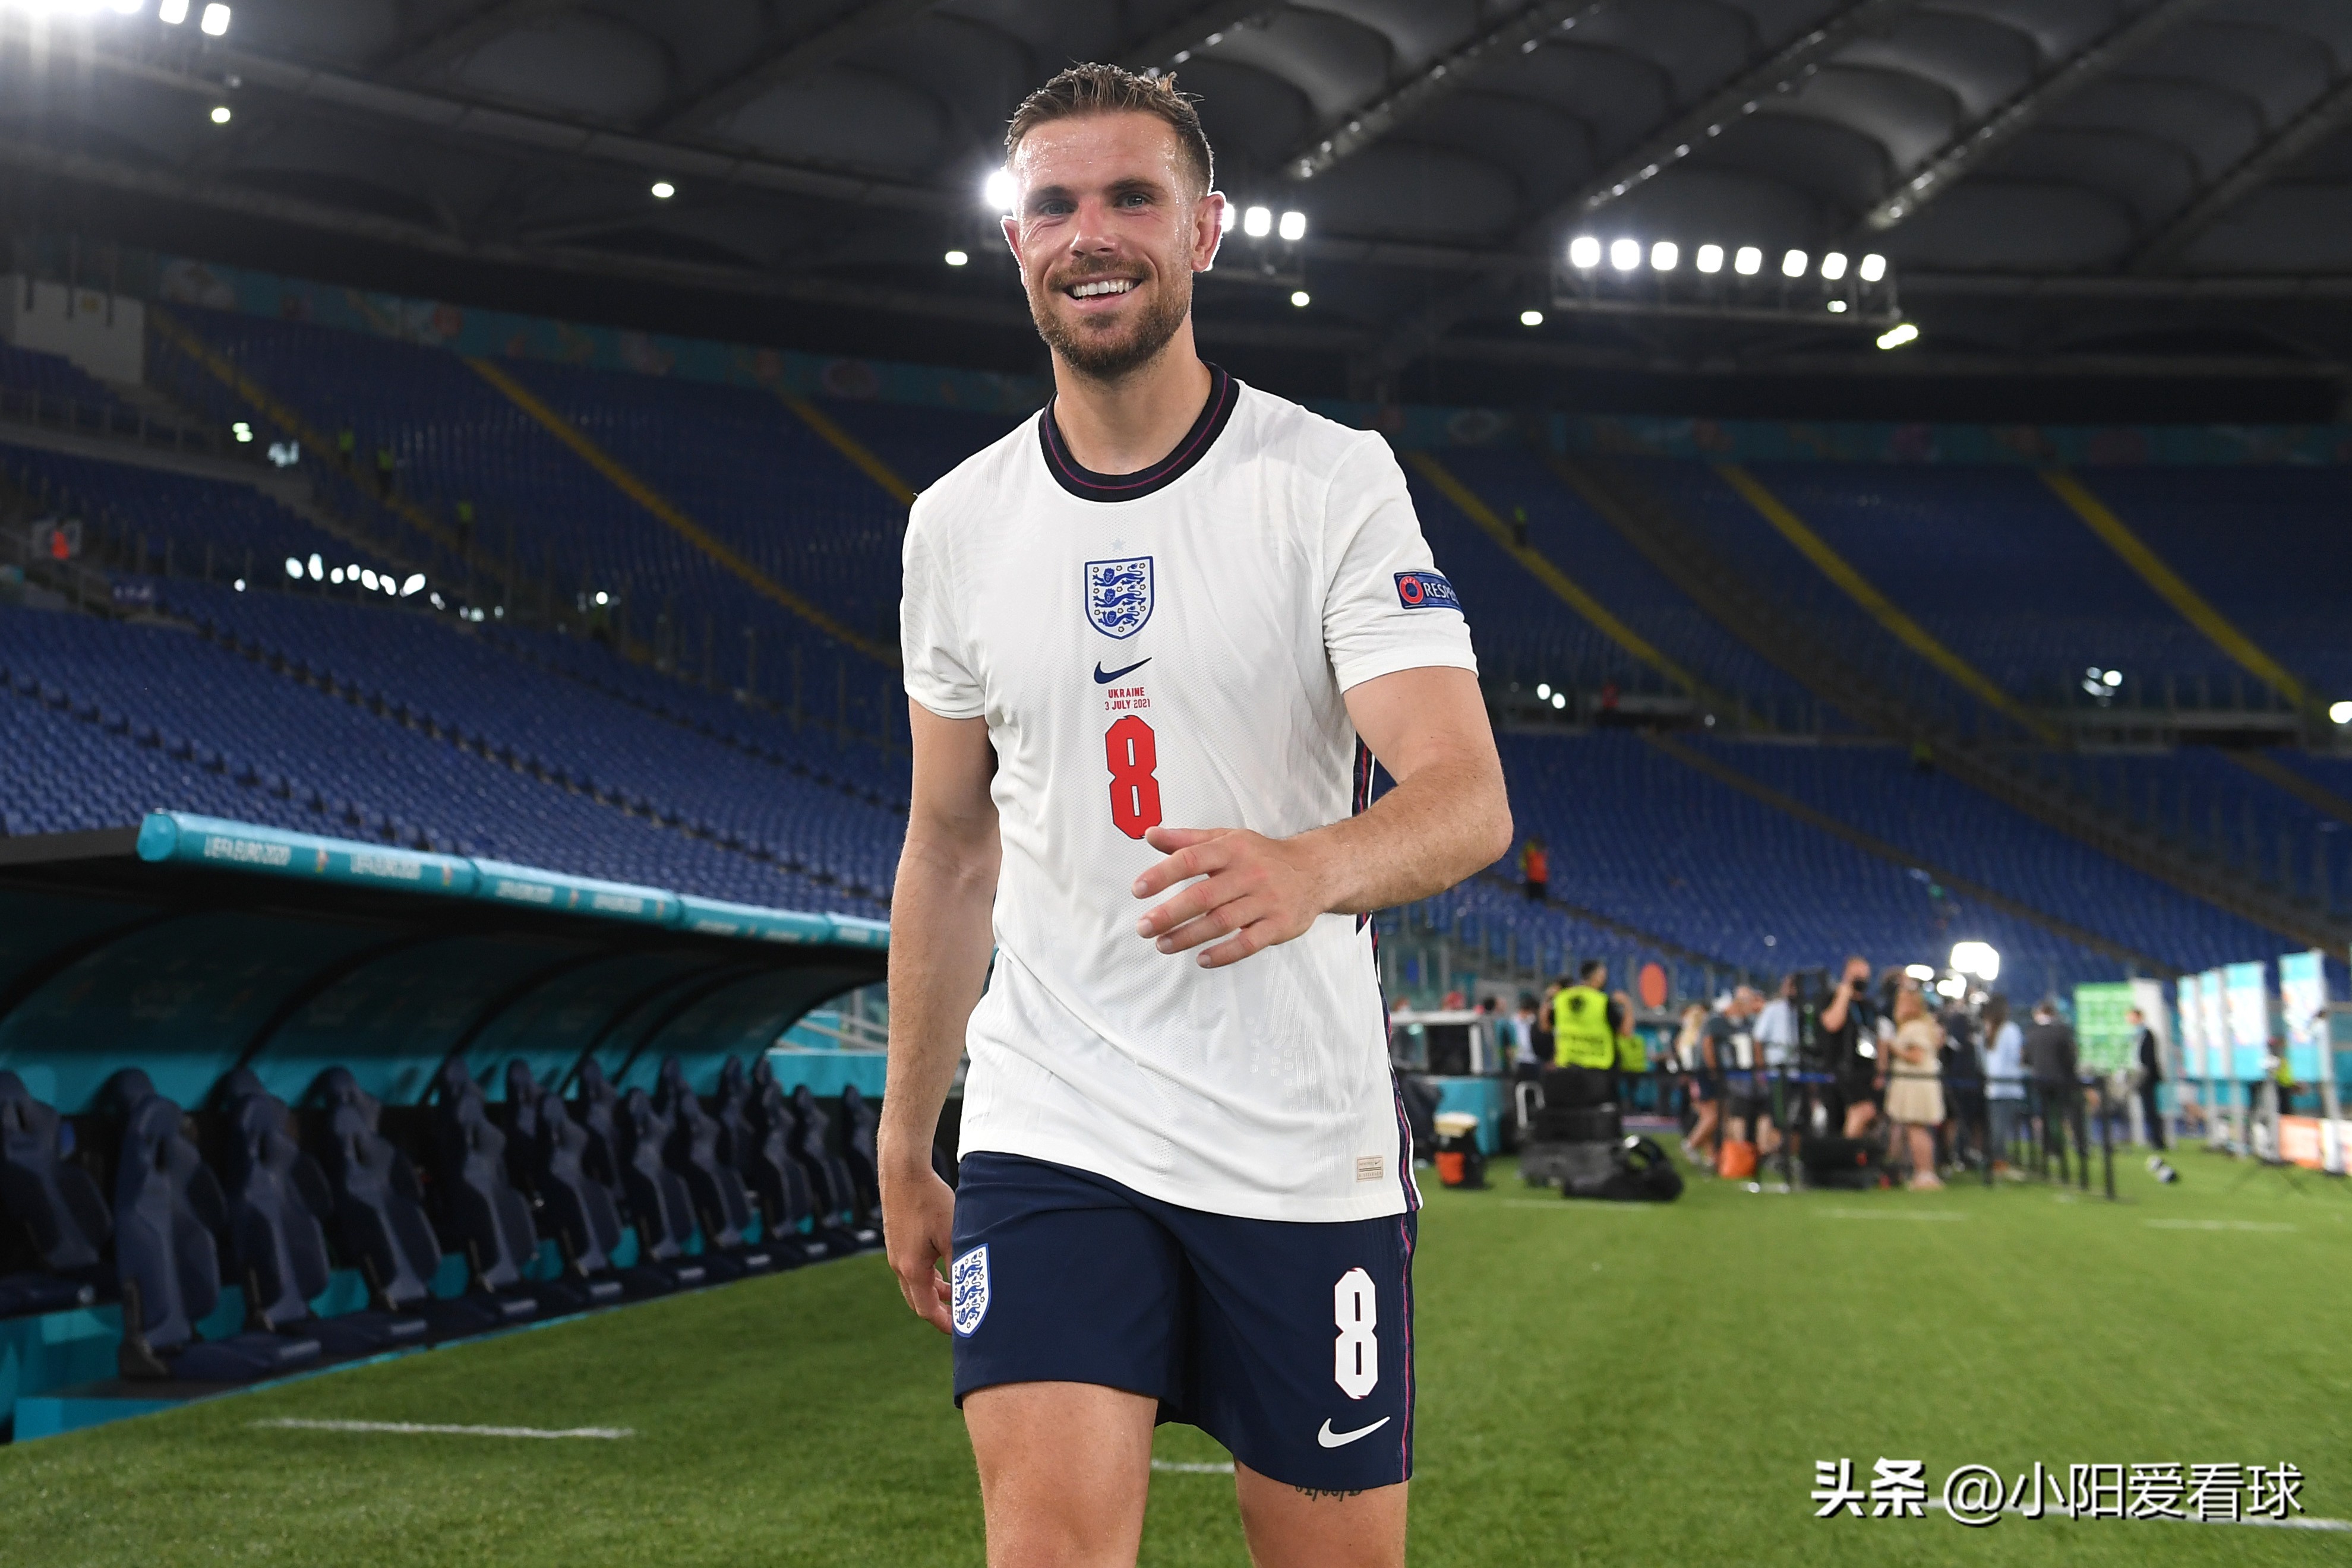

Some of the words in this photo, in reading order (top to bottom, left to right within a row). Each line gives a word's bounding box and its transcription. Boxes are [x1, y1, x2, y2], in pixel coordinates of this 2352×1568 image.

[1104, 701, 1109, 711] 3
[1112, 700, 1131, 710] JULY
[1133, 698, 1150, 709] 2021
[1108, 687, 1145, 698] UKRAINE
[1104, 715, 1163, 840] 8
[1335, 1267, 1378, 1400] 8
